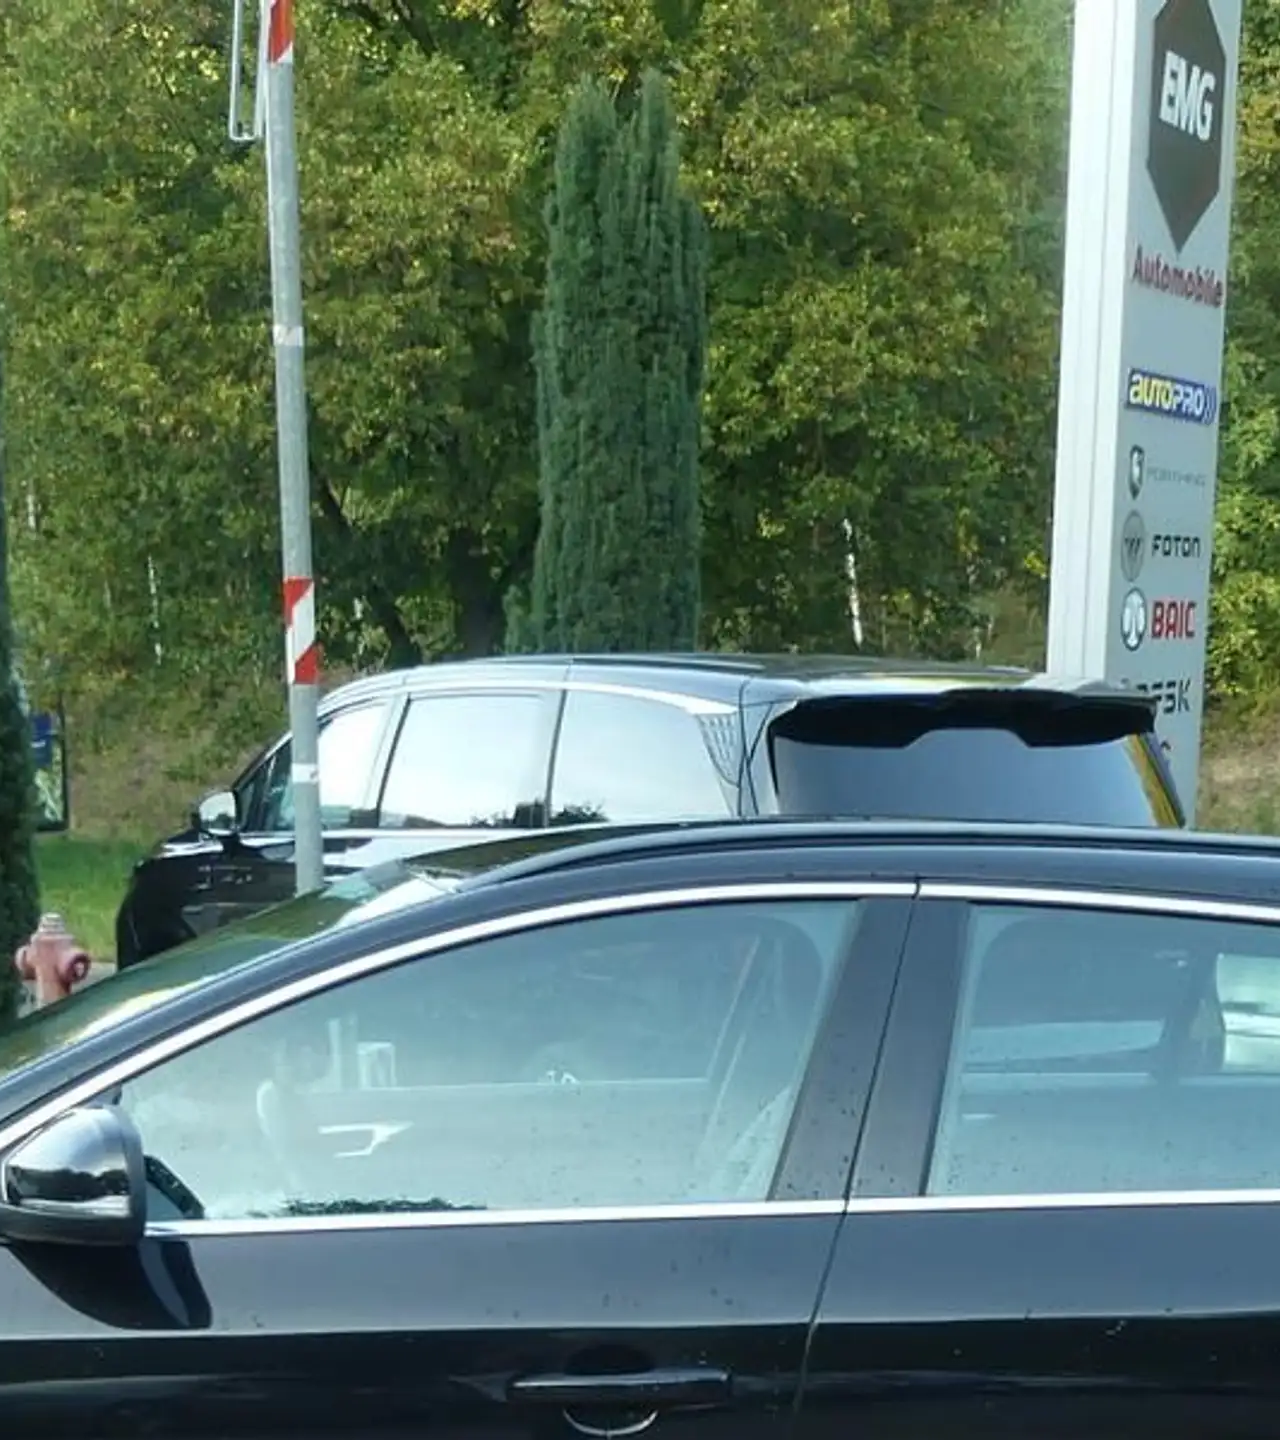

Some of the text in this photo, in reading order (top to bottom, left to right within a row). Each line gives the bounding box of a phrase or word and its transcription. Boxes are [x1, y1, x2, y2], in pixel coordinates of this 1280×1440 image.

[1159, 50, 1216, 142] EMG
[1132, 246, 1223, 307] Automobile
[1151, 600, 1197, 640] BAIC
